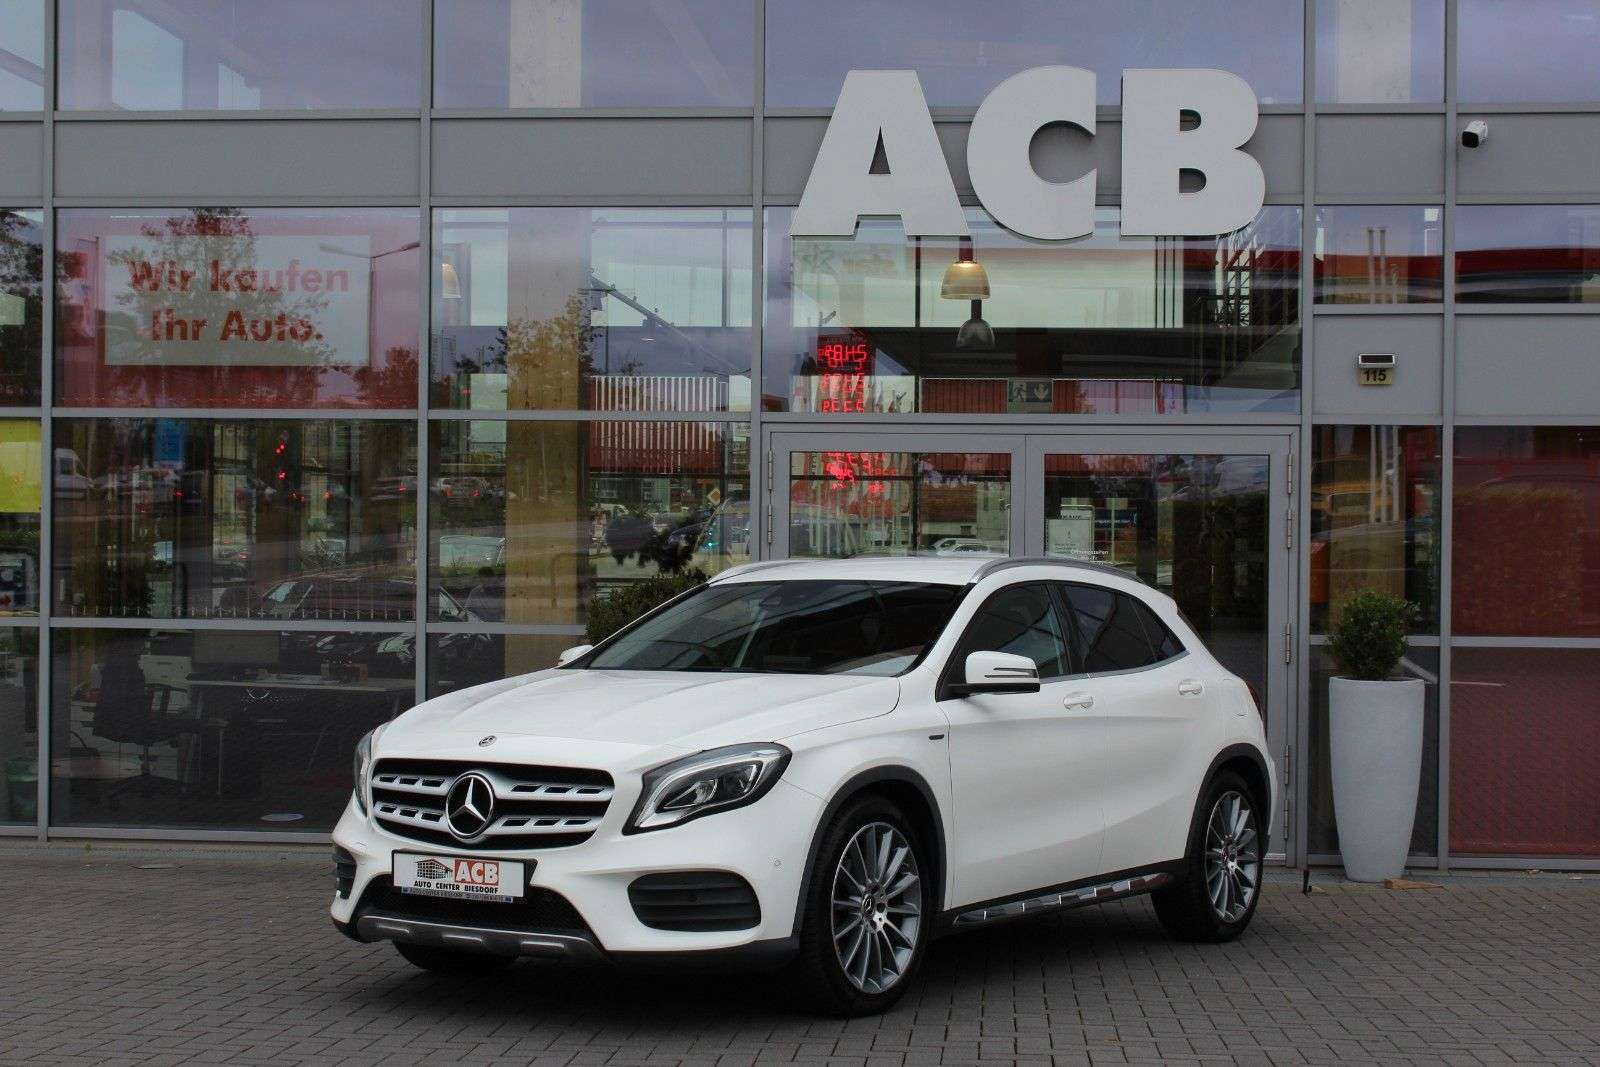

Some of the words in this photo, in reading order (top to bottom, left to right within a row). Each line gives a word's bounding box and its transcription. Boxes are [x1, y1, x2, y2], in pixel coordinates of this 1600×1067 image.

[790, 65, 1266, 241] ACB
[128, 259, 195, 293] Wir
[209, 258, 348, 293] kaufen
[152, 309, 208, 341] Ihr
[220, 309, 323, 342] Auto.
[1364, 369, 1387, 381] 115
[456, 861, 499, 884] ACB
[413, 880, 432, 888] AUTO
[435, 883, 460, 891] CENTER
[464, 885, 499, 894] BIESDORF
